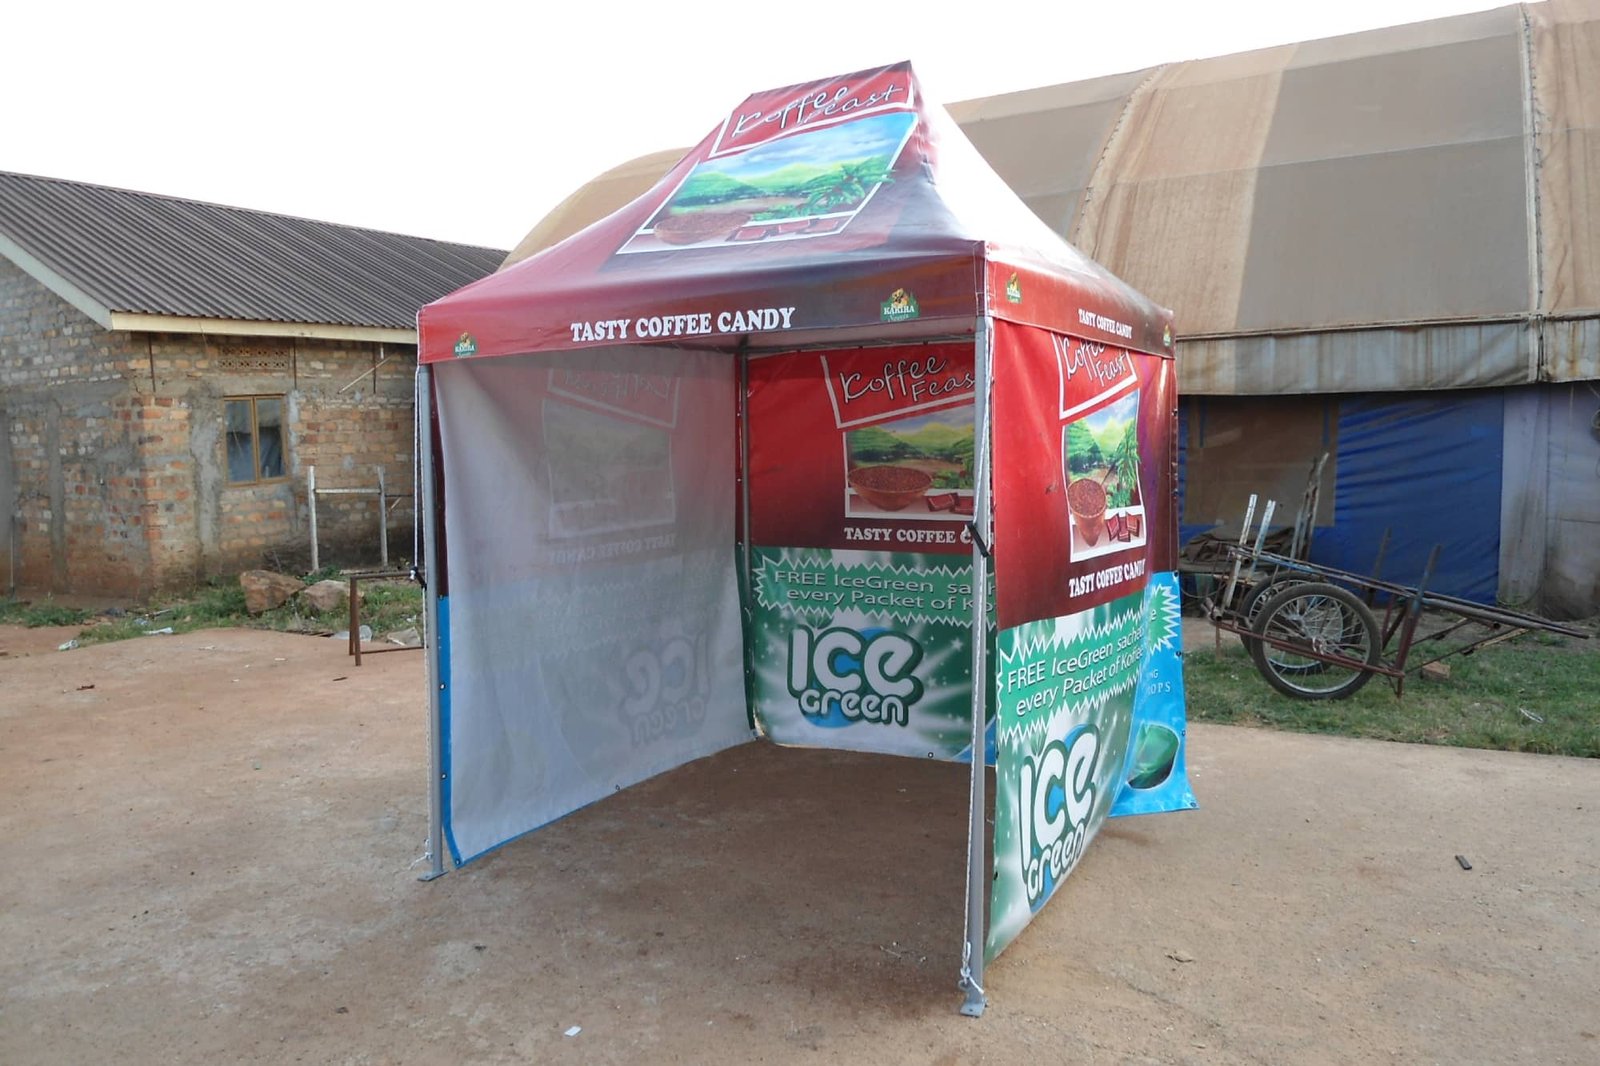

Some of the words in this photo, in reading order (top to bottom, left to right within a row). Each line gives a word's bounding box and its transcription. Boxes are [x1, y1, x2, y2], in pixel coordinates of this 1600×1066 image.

[570, 319, 631, 342] TASTY
[635, 312, 712, 338] COFFEE
[717, 307, 796, 332] CANDY
[1078, 308, 1097, 328] TASTY
[1096, 314, 1117, 334] COFFEE
[1116, 321, 1133, 339] CANDY
[839, 355, 947, 404] Koffee
[911, 372, 976, 402] Feas
[1096, 351, 1127, 388] Feast
[843, 526, 893, 542] TASTY
[896, 528, 956, 544] COFFEE
[775, 570, 827, 586] FREE
[834, 573, 935, 594] IceGreen
[1069, 573, 1095, 598] TASTY
[1096, 565, 1124, 590] COFFEE
[1123, 558, 1146, 581] CANDY
[786, 588, 846, 606] every
[851, 590, 925, 610] Packet
[931, 597, 956, 611] of
[1008, 659, 1046, 694] FREE
[1052, 641, 1113, 677] IceGreen
[1016, 685, 1059, 718] every
[1062, 664, 1108, 698] Packet
[1108, 654, 1122, 678] of
